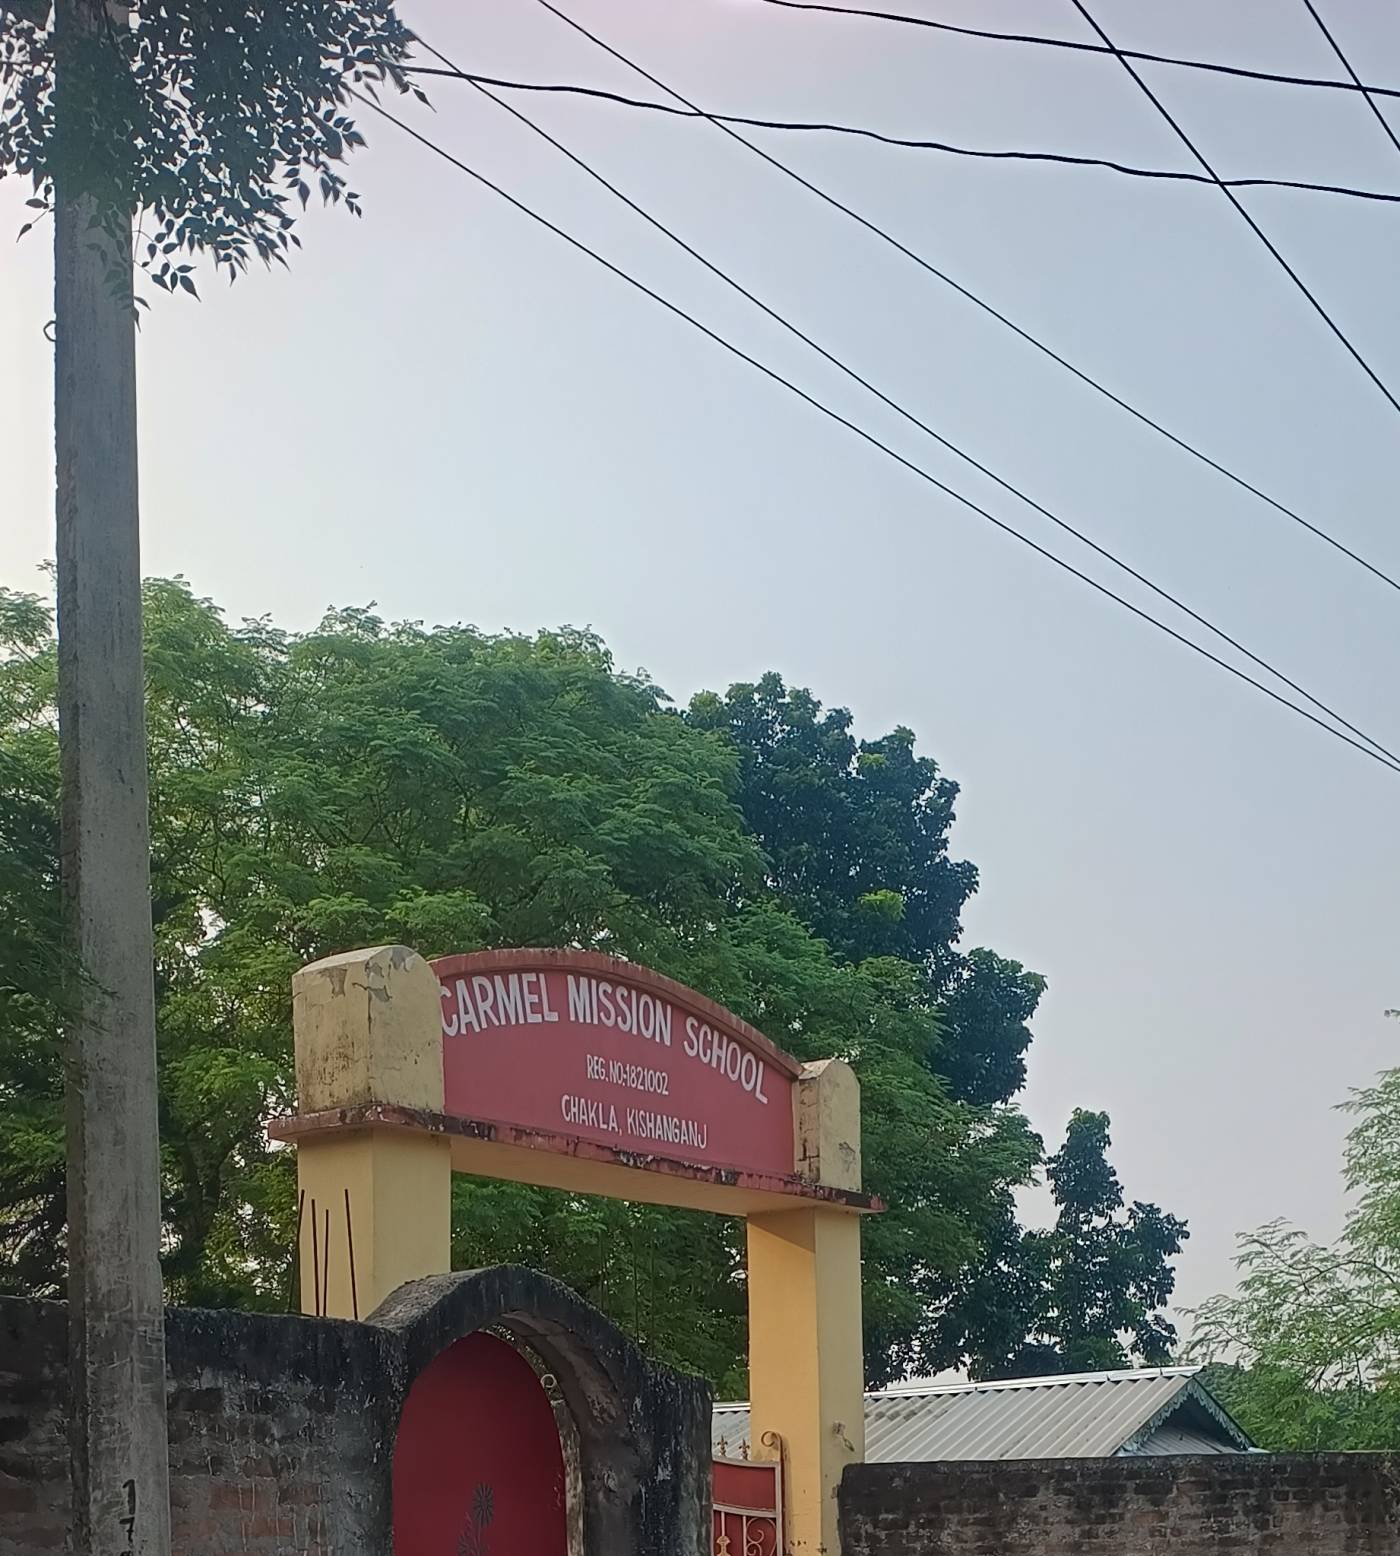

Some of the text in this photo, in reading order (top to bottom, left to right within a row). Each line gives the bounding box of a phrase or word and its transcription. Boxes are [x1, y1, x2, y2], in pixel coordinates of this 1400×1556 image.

[440, 973, 768, 1104] CARMEL MISSION SCHOOL
[561, 1094, 707, 1149] CHAKLA, KISHANGANJ
